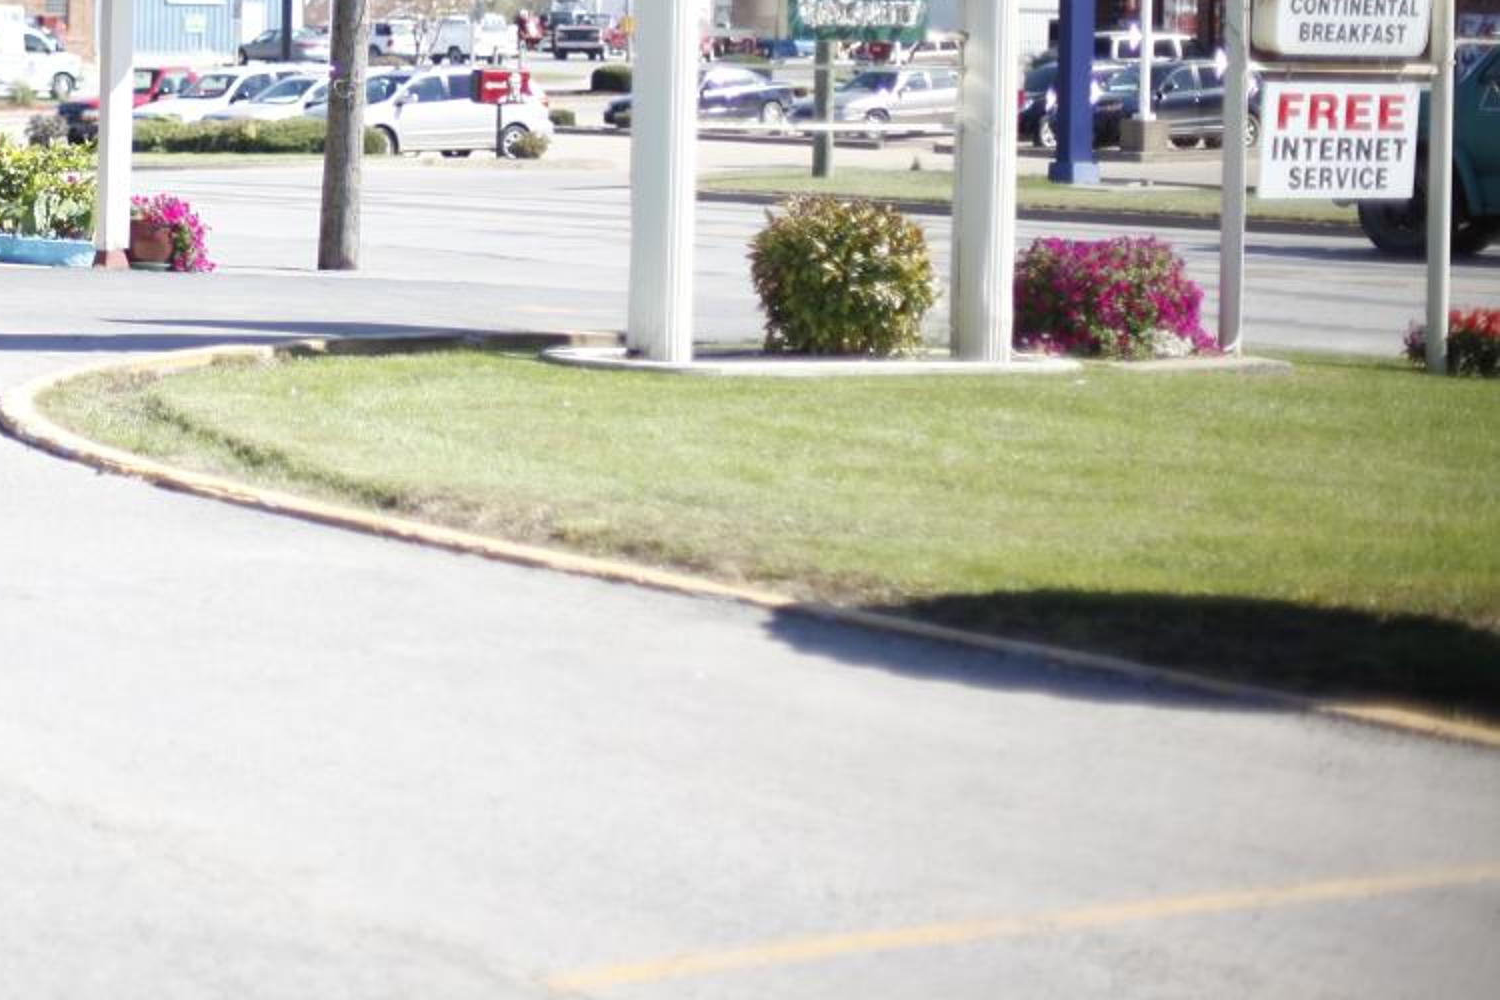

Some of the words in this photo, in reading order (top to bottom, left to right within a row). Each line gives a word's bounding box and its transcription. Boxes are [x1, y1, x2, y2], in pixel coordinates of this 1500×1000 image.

[1299, 22, 1407, 44] BREAKFAST
[1277, 92, 1406, 131] FREE
[1271, 136, 1408, 162] INTERNET
[1288, 166, 1388, 190] SERVICE
